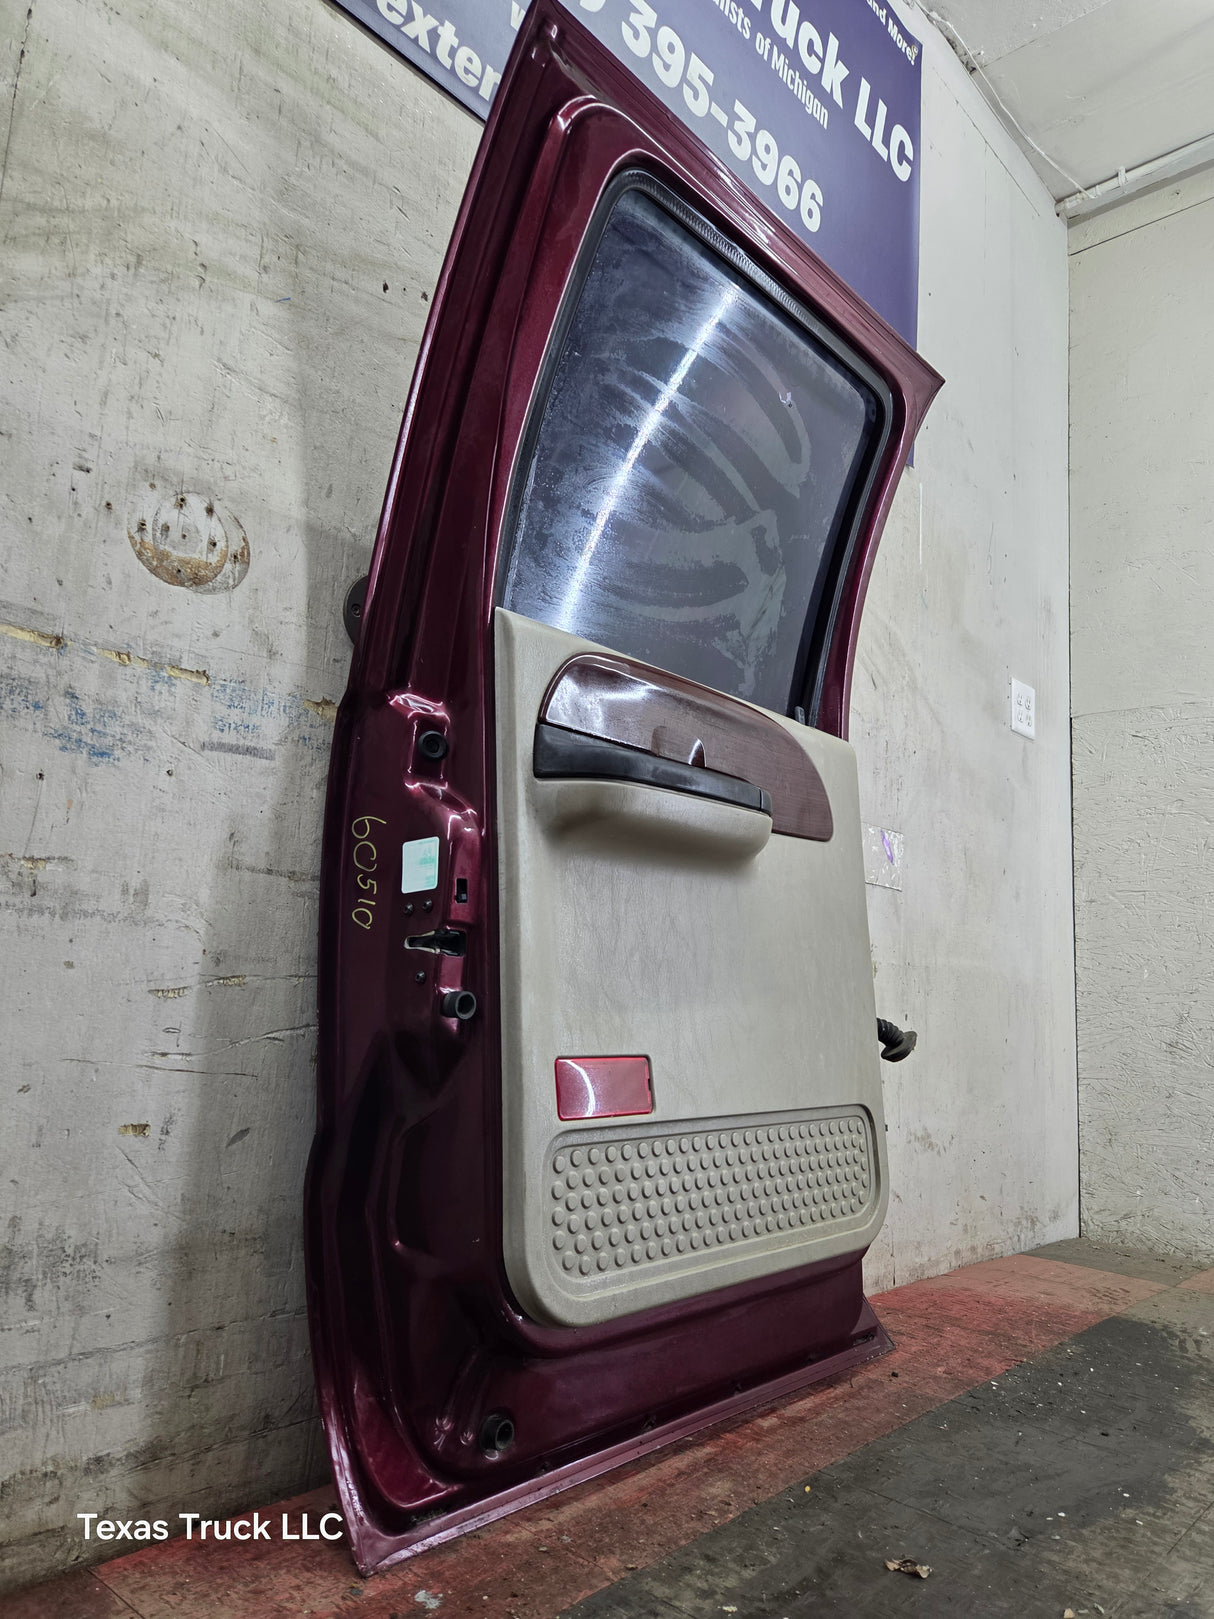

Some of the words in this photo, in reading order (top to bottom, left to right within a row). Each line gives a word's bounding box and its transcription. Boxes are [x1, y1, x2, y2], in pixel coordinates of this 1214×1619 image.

[751, 0, 850, 109] uck
[854, 76, 914, 182] LLC
[755, 32, 771, 61] of
[771, 44, 829, 130] Michigan
[888, 17, 914, 66] More!
[621, 0, 823, 233] 395-3966
